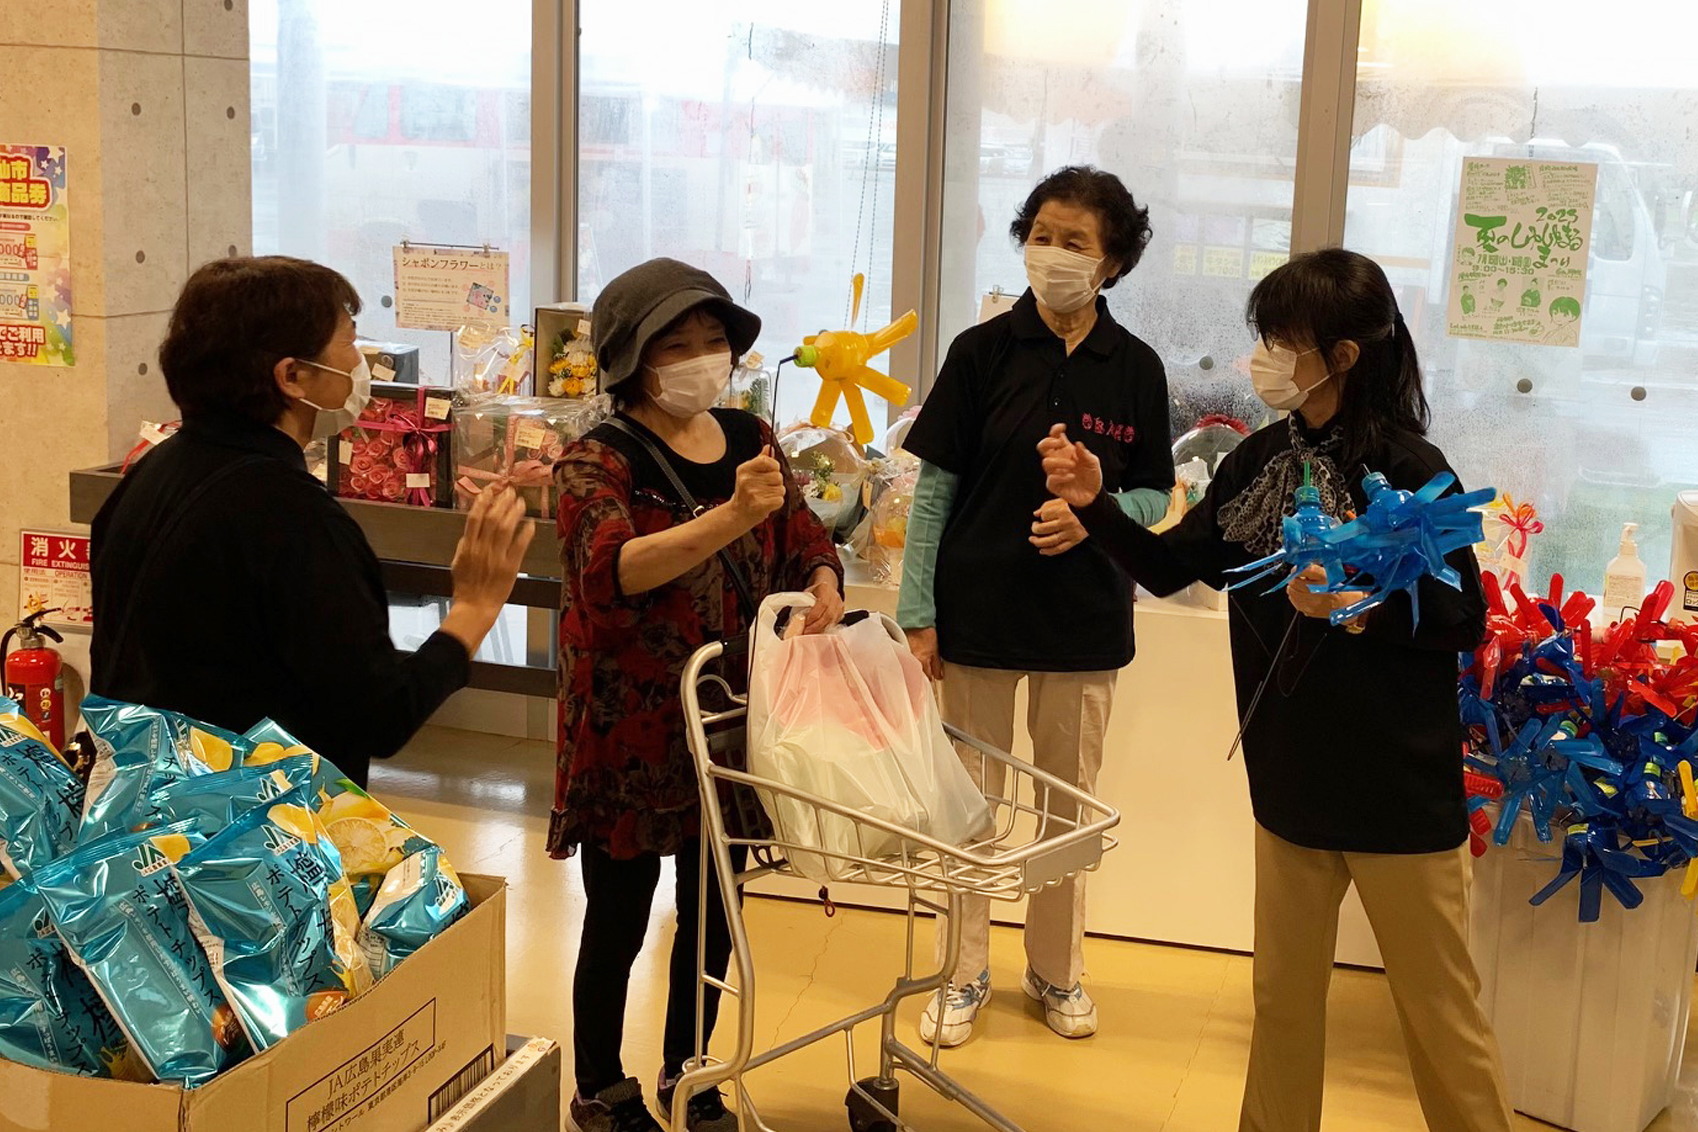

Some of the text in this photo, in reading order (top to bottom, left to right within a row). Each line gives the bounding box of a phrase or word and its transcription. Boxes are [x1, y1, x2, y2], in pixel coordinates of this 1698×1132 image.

[1535, 206, 1579, 224] 2023
[0, 341, 36, 356] ます!!
[31, 536, 90, 560] 消火
[31, 558, 90, 570] FIRE EXTINGUIS
[265, 863, 325, 994] ポテトップス
[132, 884, 221, 1008] ポテトチップス
